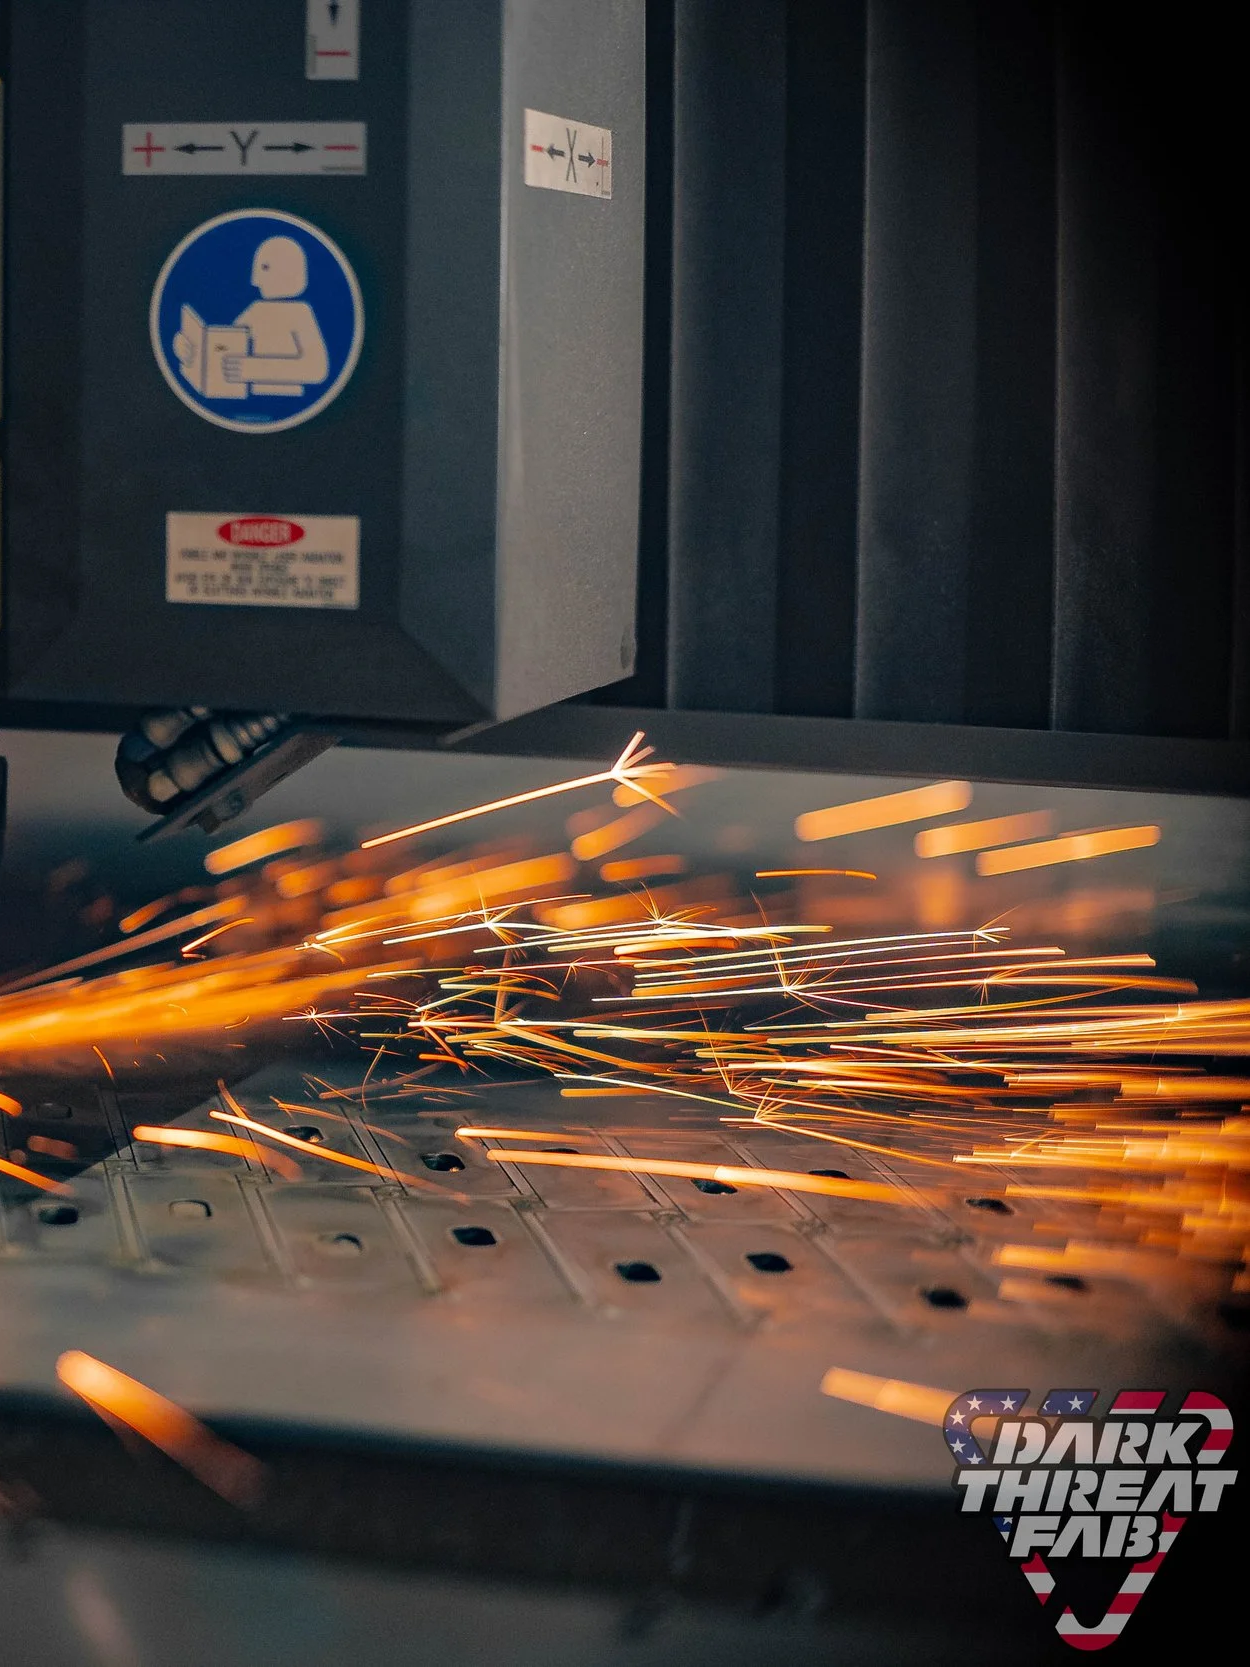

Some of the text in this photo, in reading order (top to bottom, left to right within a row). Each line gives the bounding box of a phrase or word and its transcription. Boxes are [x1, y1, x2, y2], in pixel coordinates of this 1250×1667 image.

[230, 129, 258, 166] Y
[566, 127, 578, 183] X
[230, 524, 292, 542] DANGER
